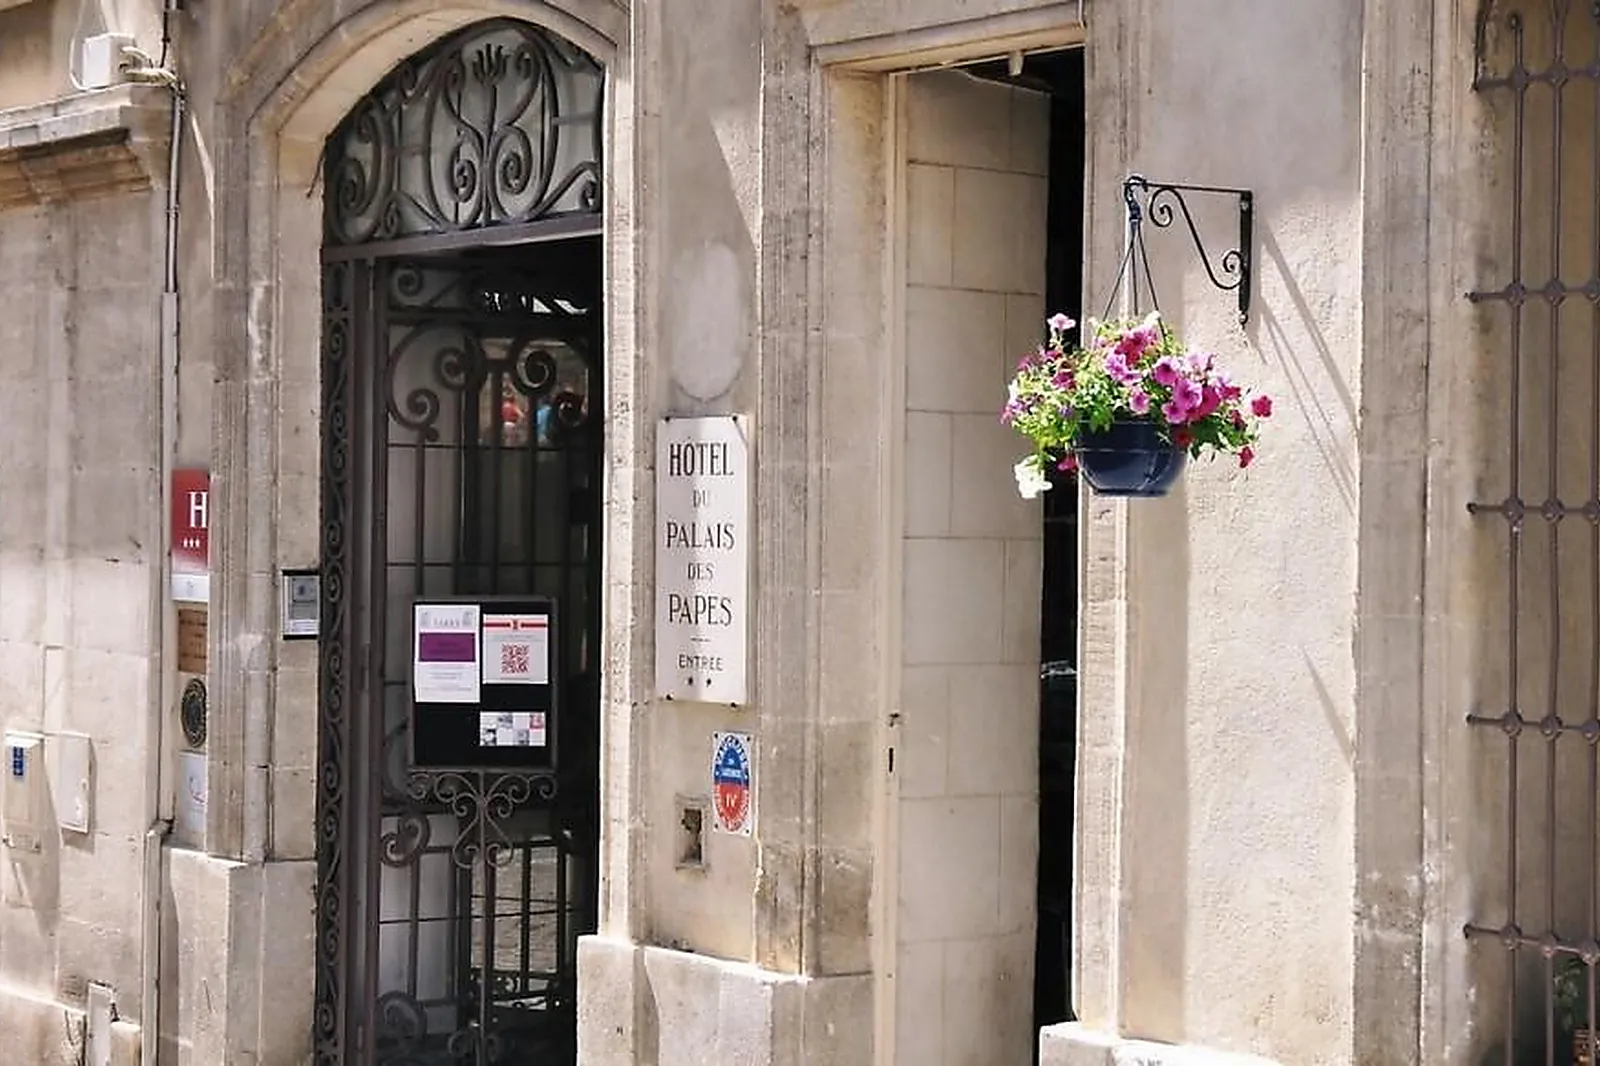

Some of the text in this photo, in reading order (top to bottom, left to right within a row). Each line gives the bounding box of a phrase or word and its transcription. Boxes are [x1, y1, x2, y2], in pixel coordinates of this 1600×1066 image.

[188, 491, 208, 528] H
[666, 521, 735, 549] PALAIS
[687, 562, 714, 580] DES
[669, 593, 732, 627] PAPES
